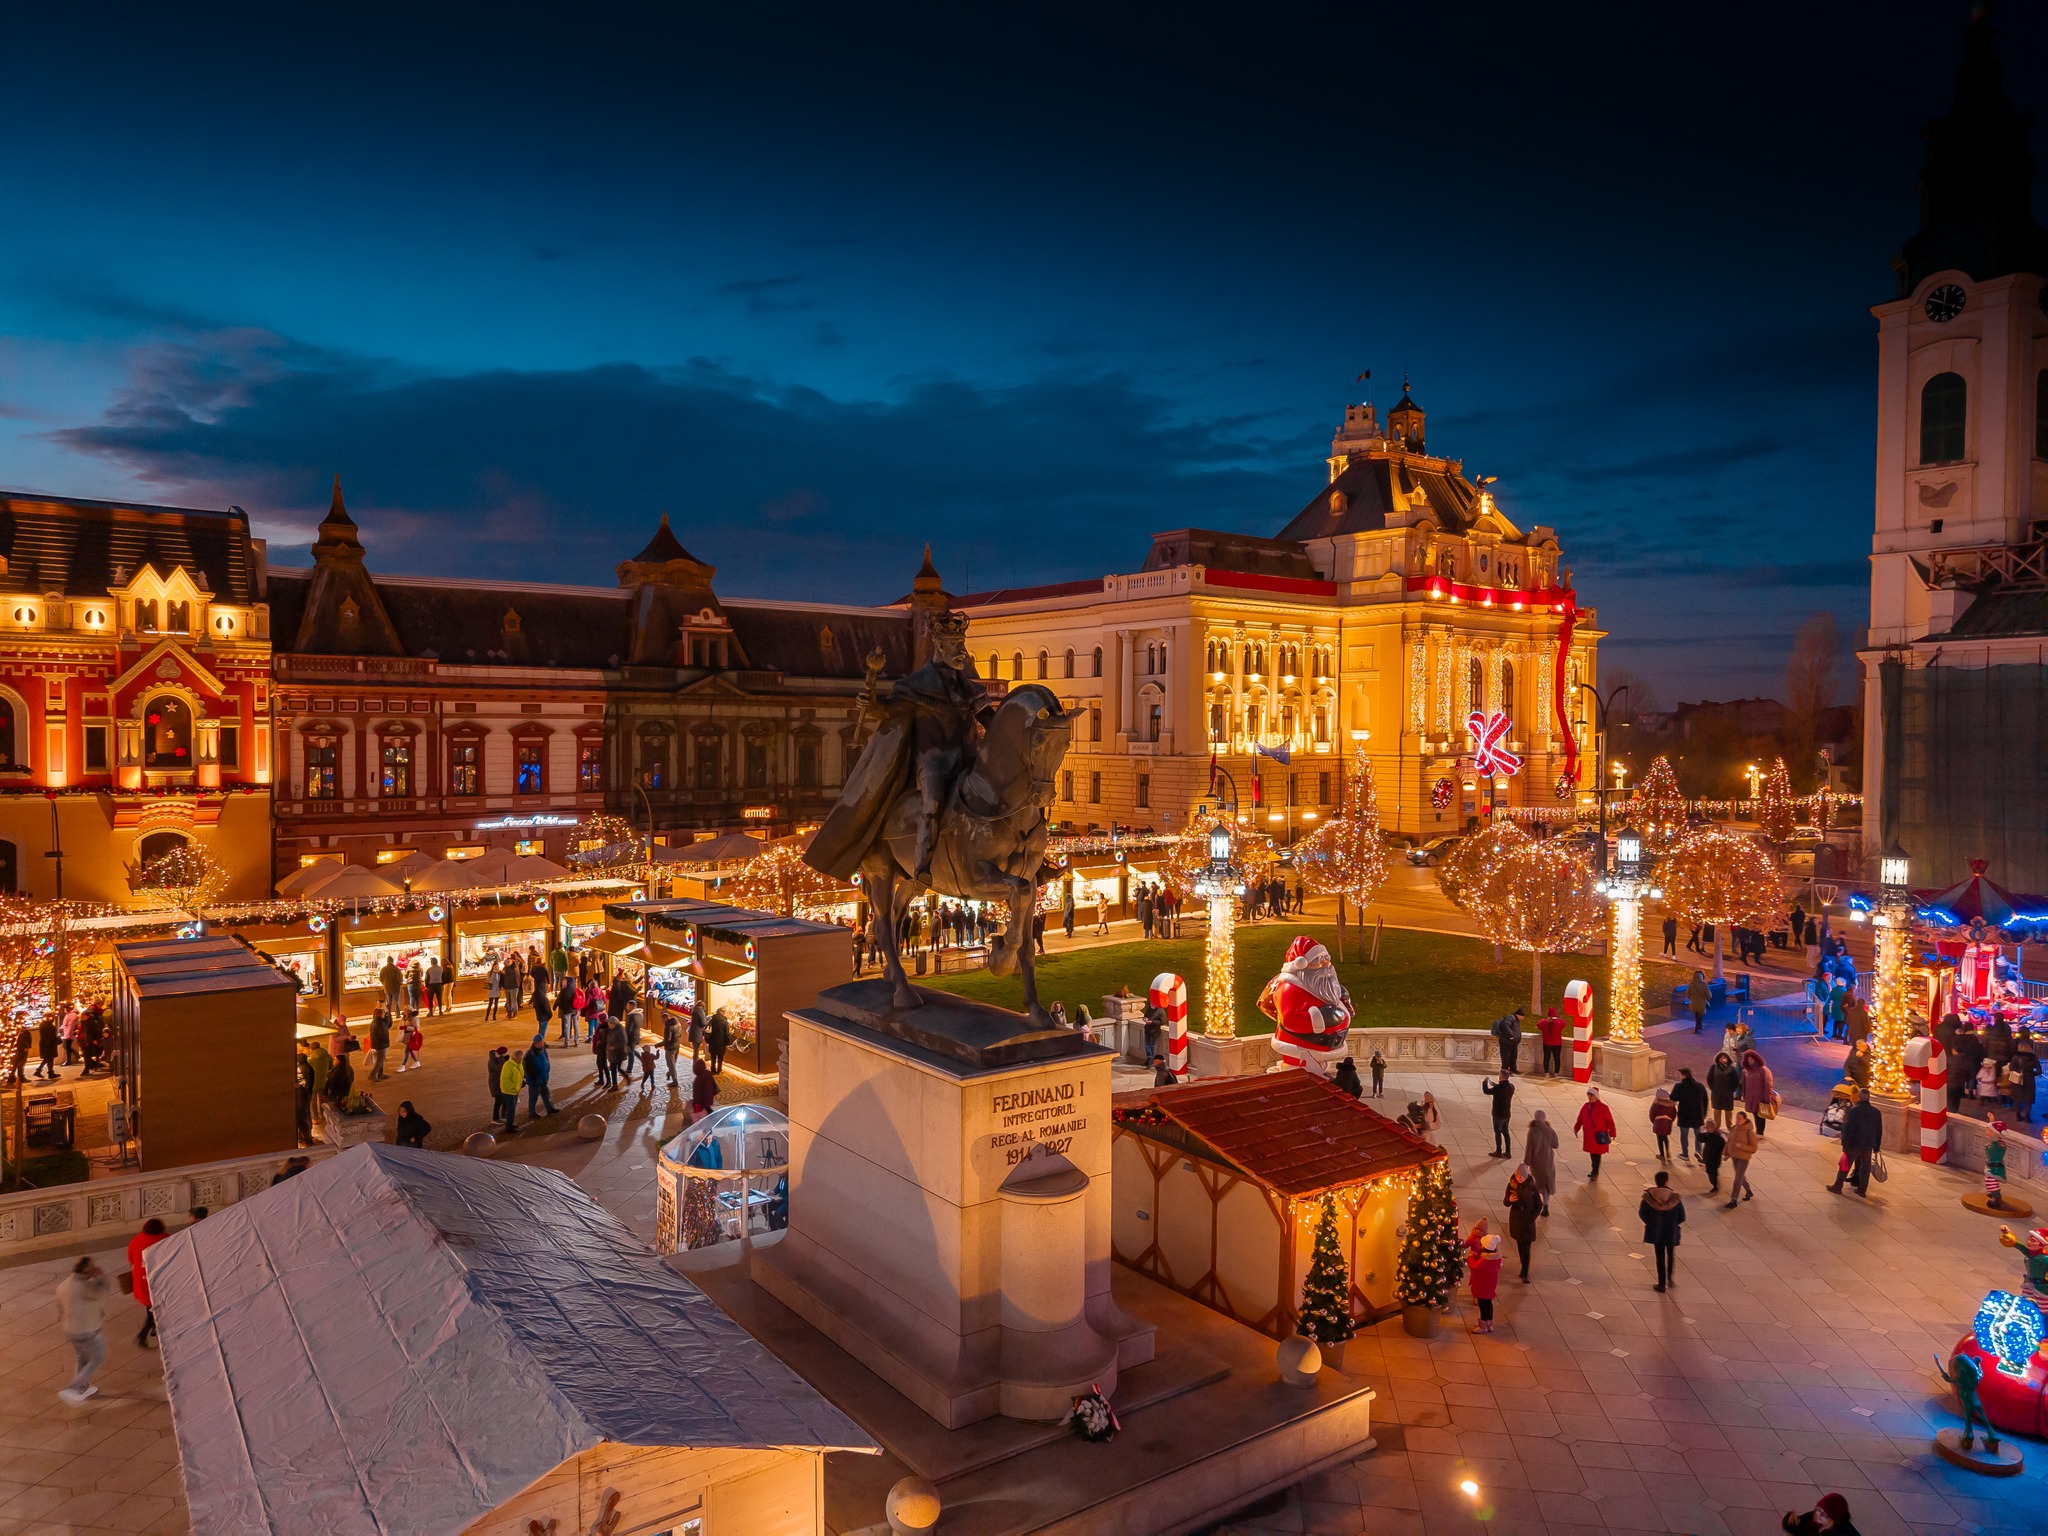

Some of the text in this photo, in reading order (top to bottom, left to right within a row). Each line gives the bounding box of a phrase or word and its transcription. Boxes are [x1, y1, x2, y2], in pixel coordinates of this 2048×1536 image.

[993, 1081, 1085, 1113] FERDINAND I
[991, 1133, 1019, 1149] REGE
[1021, 1130, 1036, 1142] AL
[1006, 1145, 1033, 1166] 1914
[1044, 1136, 1073, 1157] 1927
